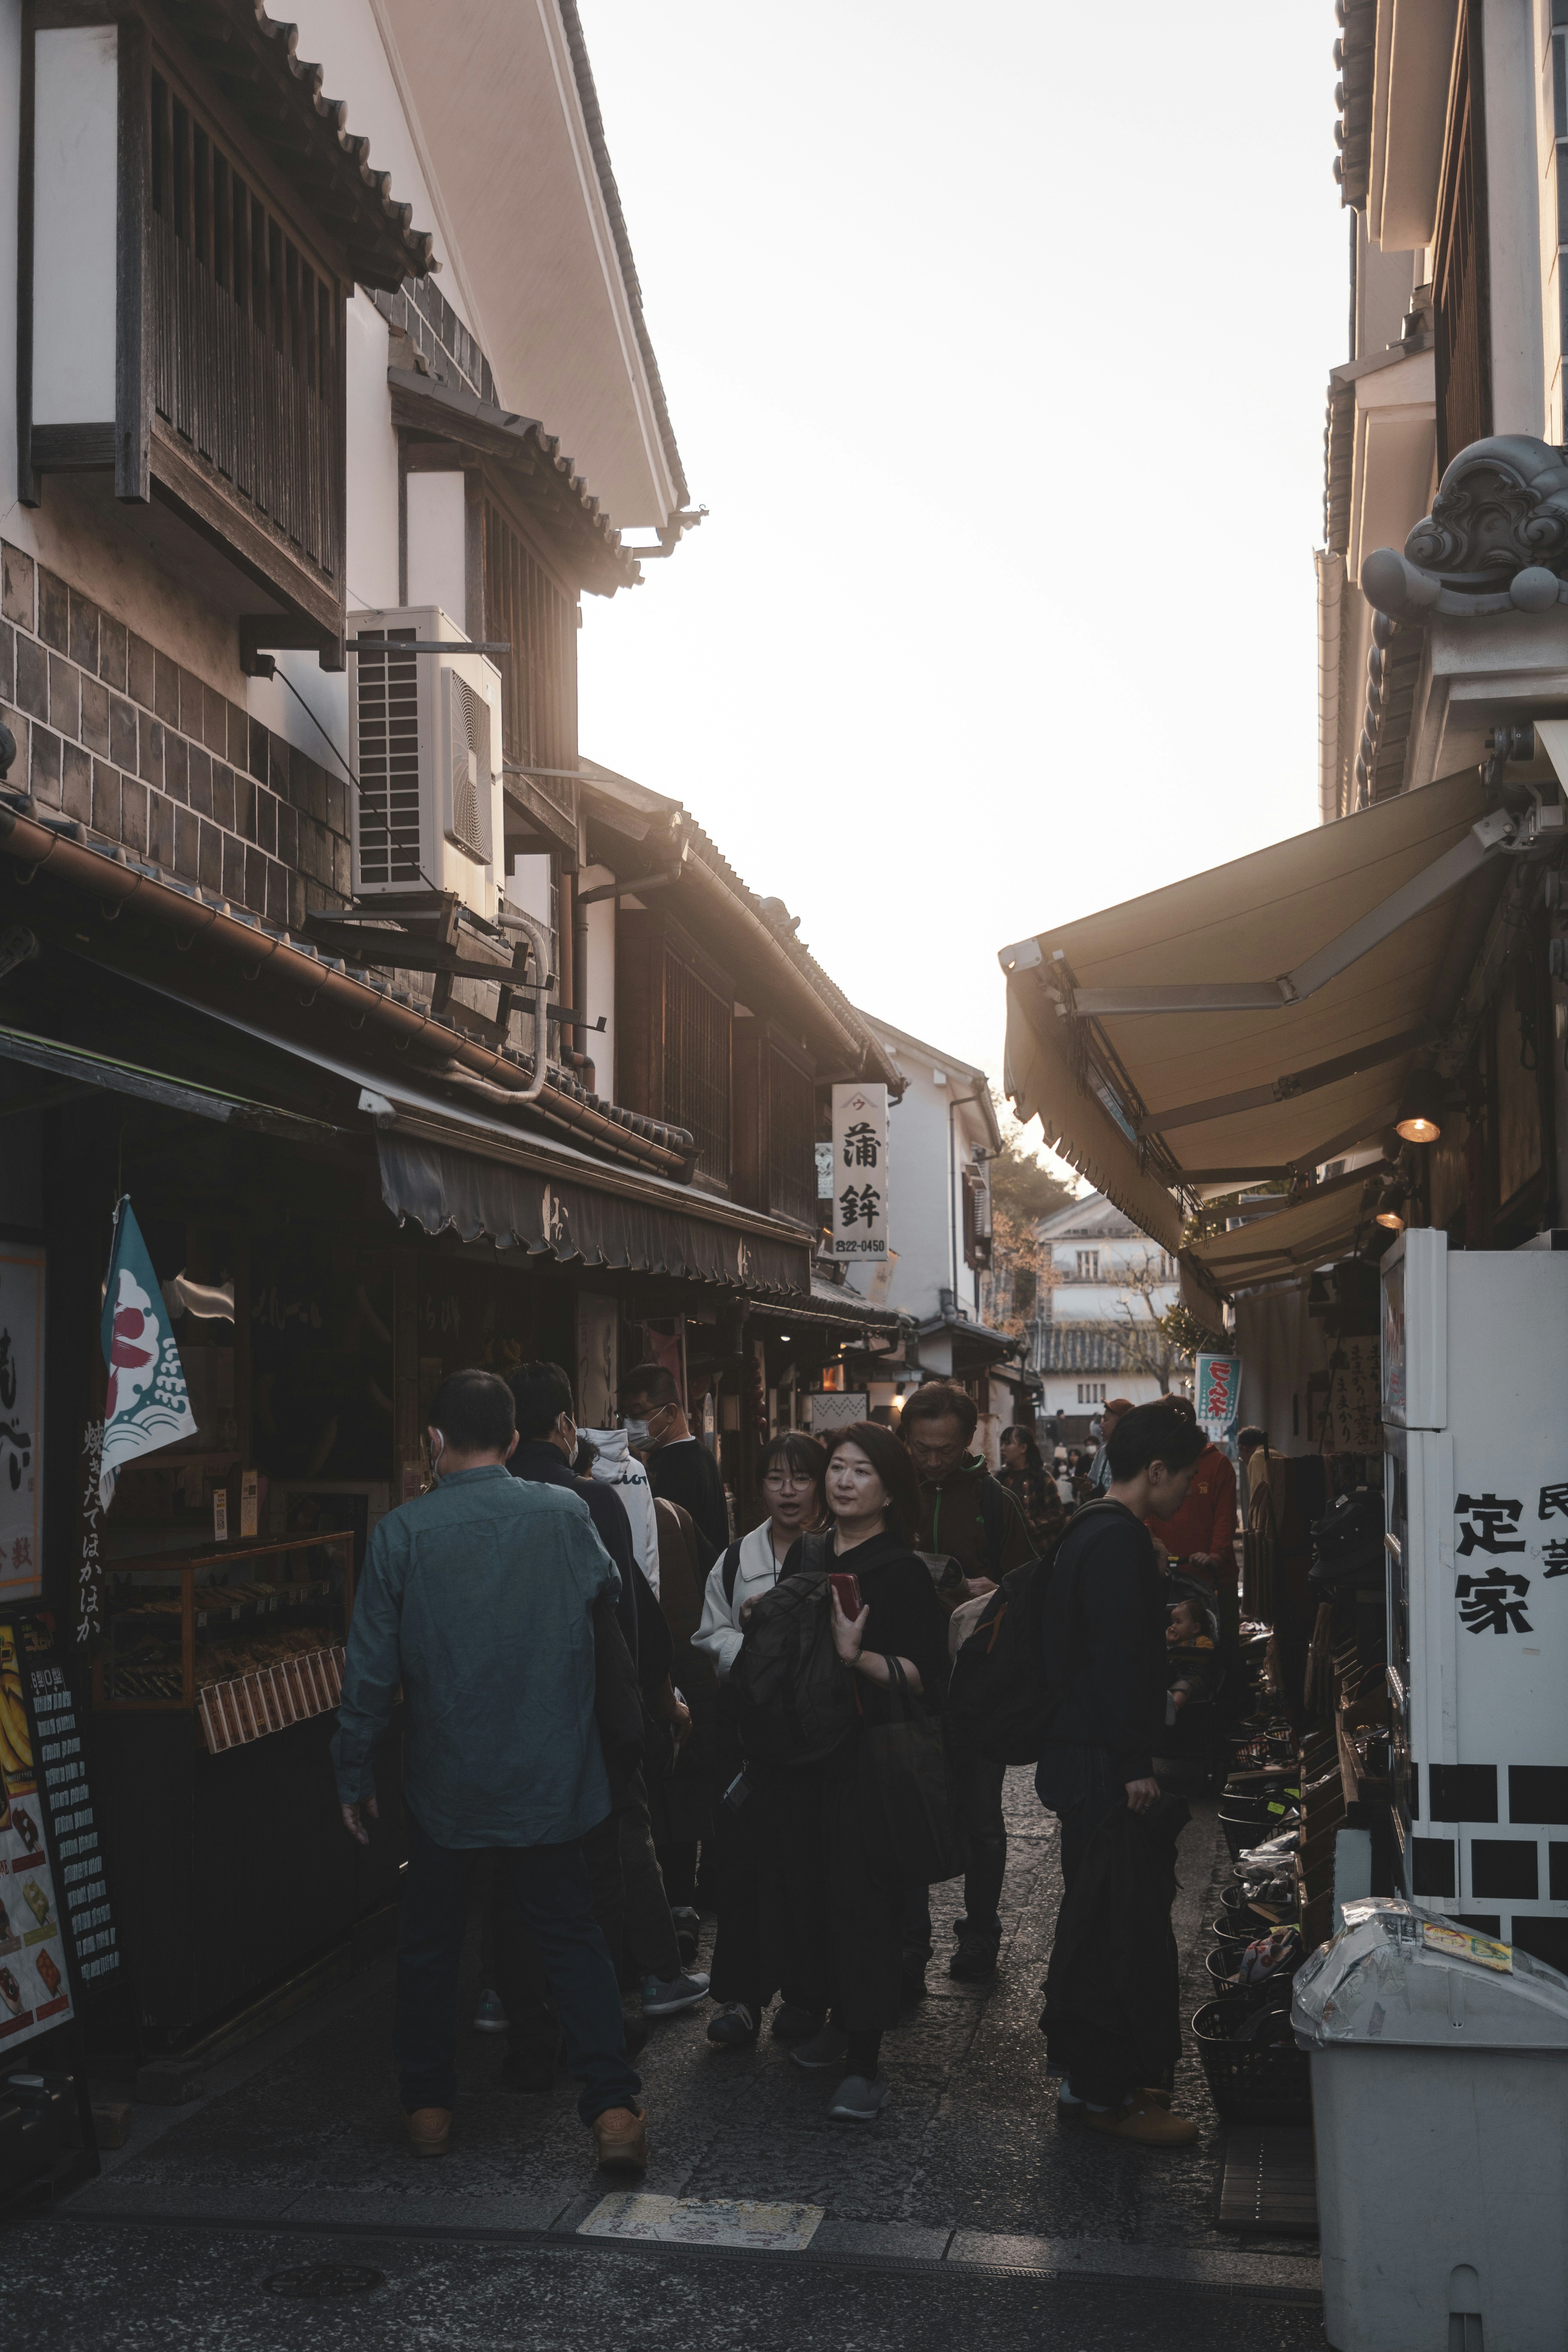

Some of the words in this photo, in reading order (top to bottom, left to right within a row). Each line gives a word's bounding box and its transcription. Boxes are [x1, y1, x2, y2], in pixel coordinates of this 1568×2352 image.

[839, 1122, 881, 1229] 蒲鉾
[846, 1240, 885, 1252] 22-0450
[76, 1420, 104, 1643] 焼きたてほかほか
[1454, 1493, 1534, 1635] 定家
[205, 1690, 220, 1736] 特上のり
